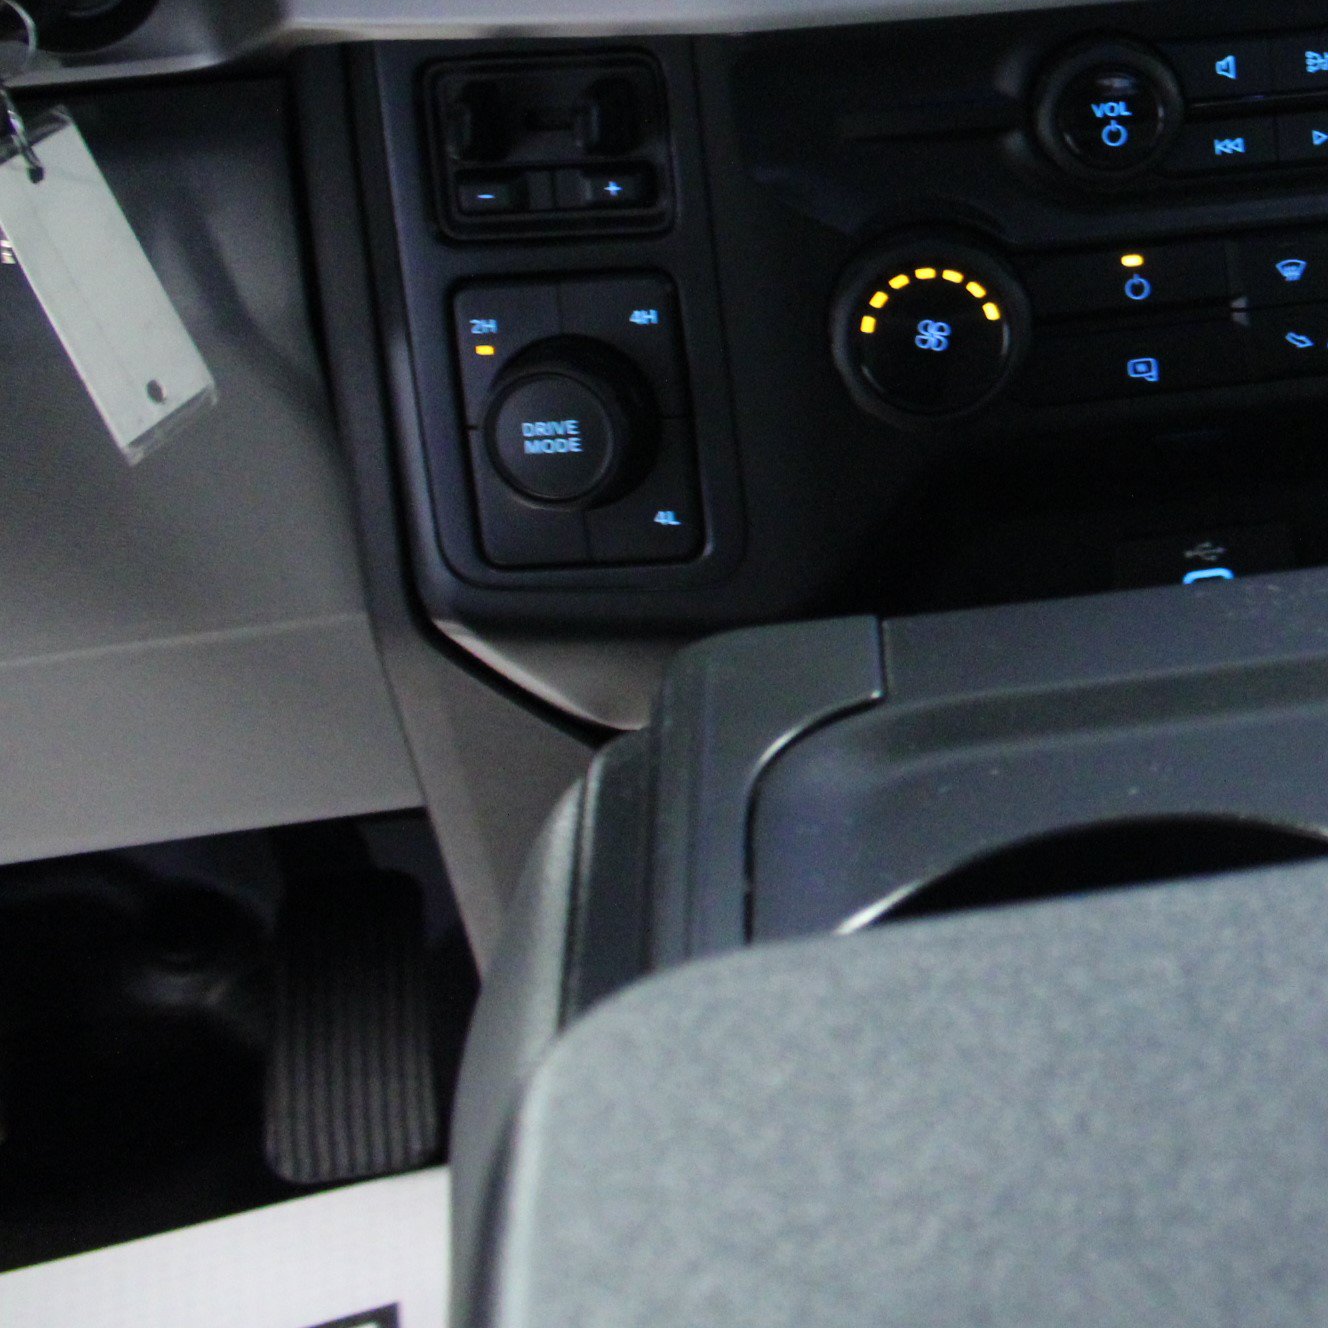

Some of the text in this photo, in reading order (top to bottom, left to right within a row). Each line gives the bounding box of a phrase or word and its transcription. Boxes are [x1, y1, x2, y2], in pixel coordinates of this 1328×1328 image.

[1090, 101, 1133, 118] VOL
[629, 309, 658, 324] 4H
[469, 319, 498, 334] 2H
[522, 420, 580, 437] DRIVE
[524, 437, 583, 454] MODE
[653, 510, 681, 525] 4L
